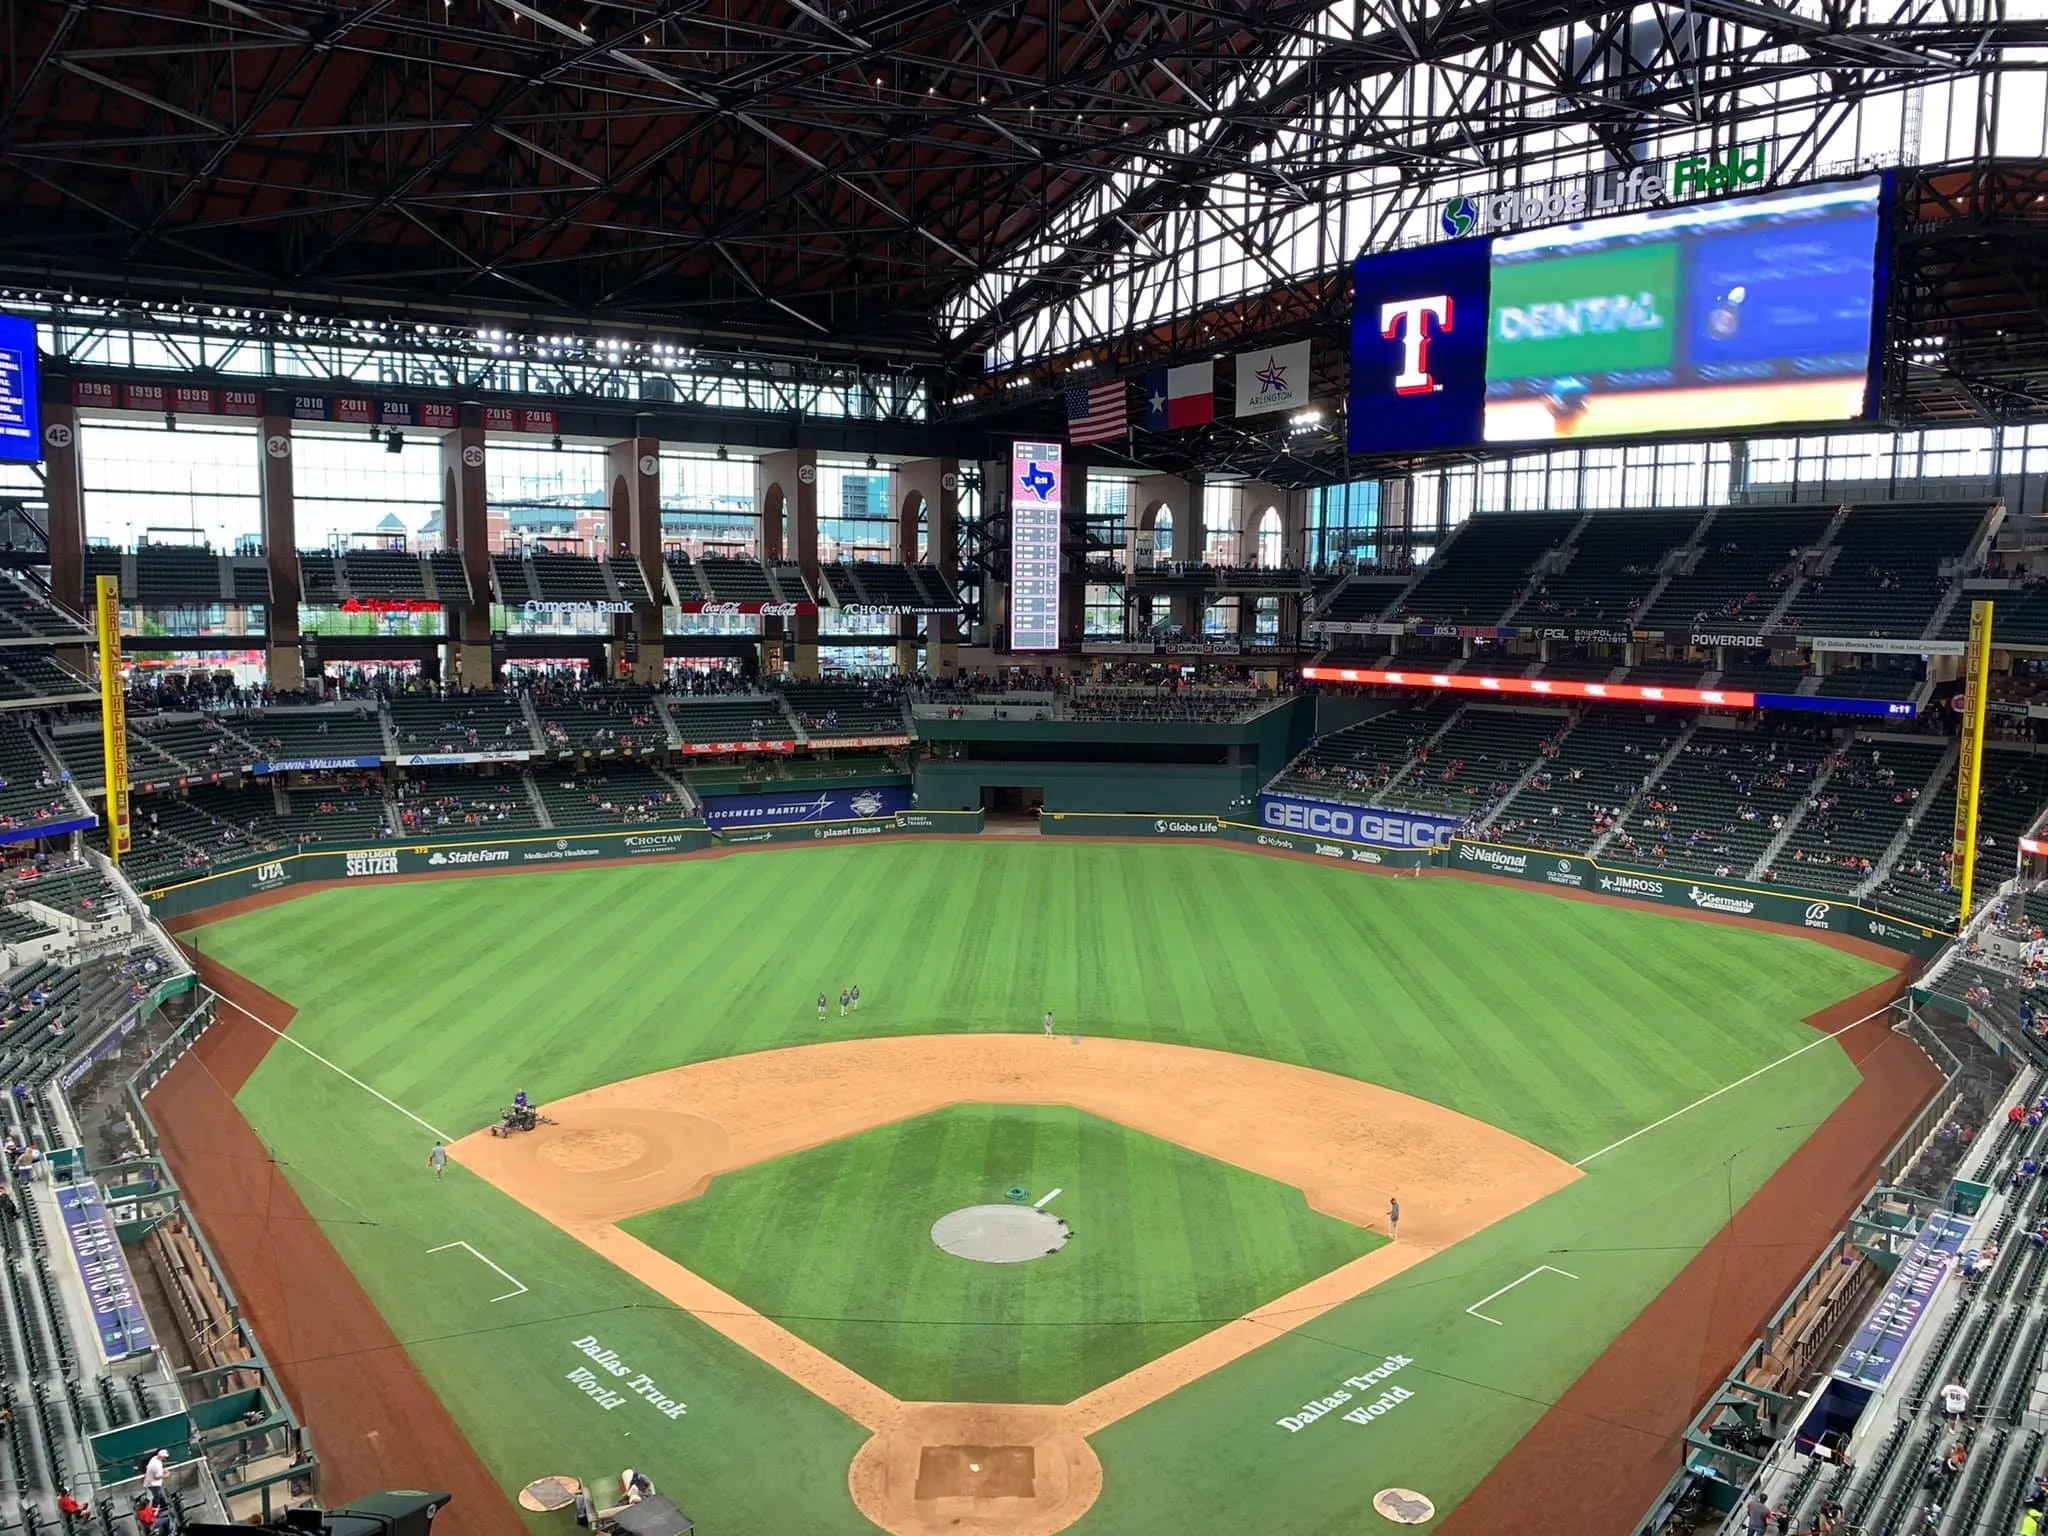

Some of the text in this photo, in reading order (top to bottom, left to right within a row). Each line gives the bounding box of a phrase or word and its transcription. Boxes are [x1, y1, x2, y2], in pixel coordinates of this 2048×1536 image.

[1487, 144, 1764, 227] Globe Life Field
[79, 382, 112, 396] 1996
[129, 385, 162, 399] 1998
[177, 388, 210, 401] 1999
[226, 391, 256, 405] 2010
[296, 397, 324, 409] 2010
[1249, 391, 1293, 406] ARLINGTON
[341, 399, 367, 411] 2011
[383, 402, 409, 415] 2011
[425, 404, 453, 417] 2012
[486, 408, 513, 421] 2015
[526, 410, 552, 423] 2016
[50, 429, 69, 442] 42
[270, 441, 288, 453] 34
[465, 451, 482, 462] 26
[800, 468, 814, 480] 29
[945, 477, 955, 488] 10
[597, 601, 634, 613] Bank
[850, 604, 912, 614] CHOCTAW
[1434, 627, 1457, 635] 105.3
[1544, 628, 1569, 639] PGL
[1691, 634, 1764, 647] POWERADE
[708, 806, 807, 819] LOCKHEED MARTIN
[1169, 822, 1217, 833] Globe Life
[1265, 802, 1451, 848] GEICO GEICO
[824, 826, 881, 838] planet fitness
[631, 835, 682, 845] CHOCTAW
[1268, 837, 1293, 849] Kubota
[524, 852, 549, 860] Medical
[550, 850, 563, 859] City
[1474, 848, 1527, 867] National
[258, 863, 284, 881] UTA
[346, 857, 398, 877] SELTZER
[1504, 865, 1524, 873] Rental
[1707, 893, 1755, 909] Germania
[1805, 919, 1829, 929] SPORTS
[571, 1335, 688, 1420] Dallas Truck
[566, 1366, 627, 1410] World
[1276, 1354, 1414, 1433] Dallas Truck
[1342, 1385, 1415, 1425] World
